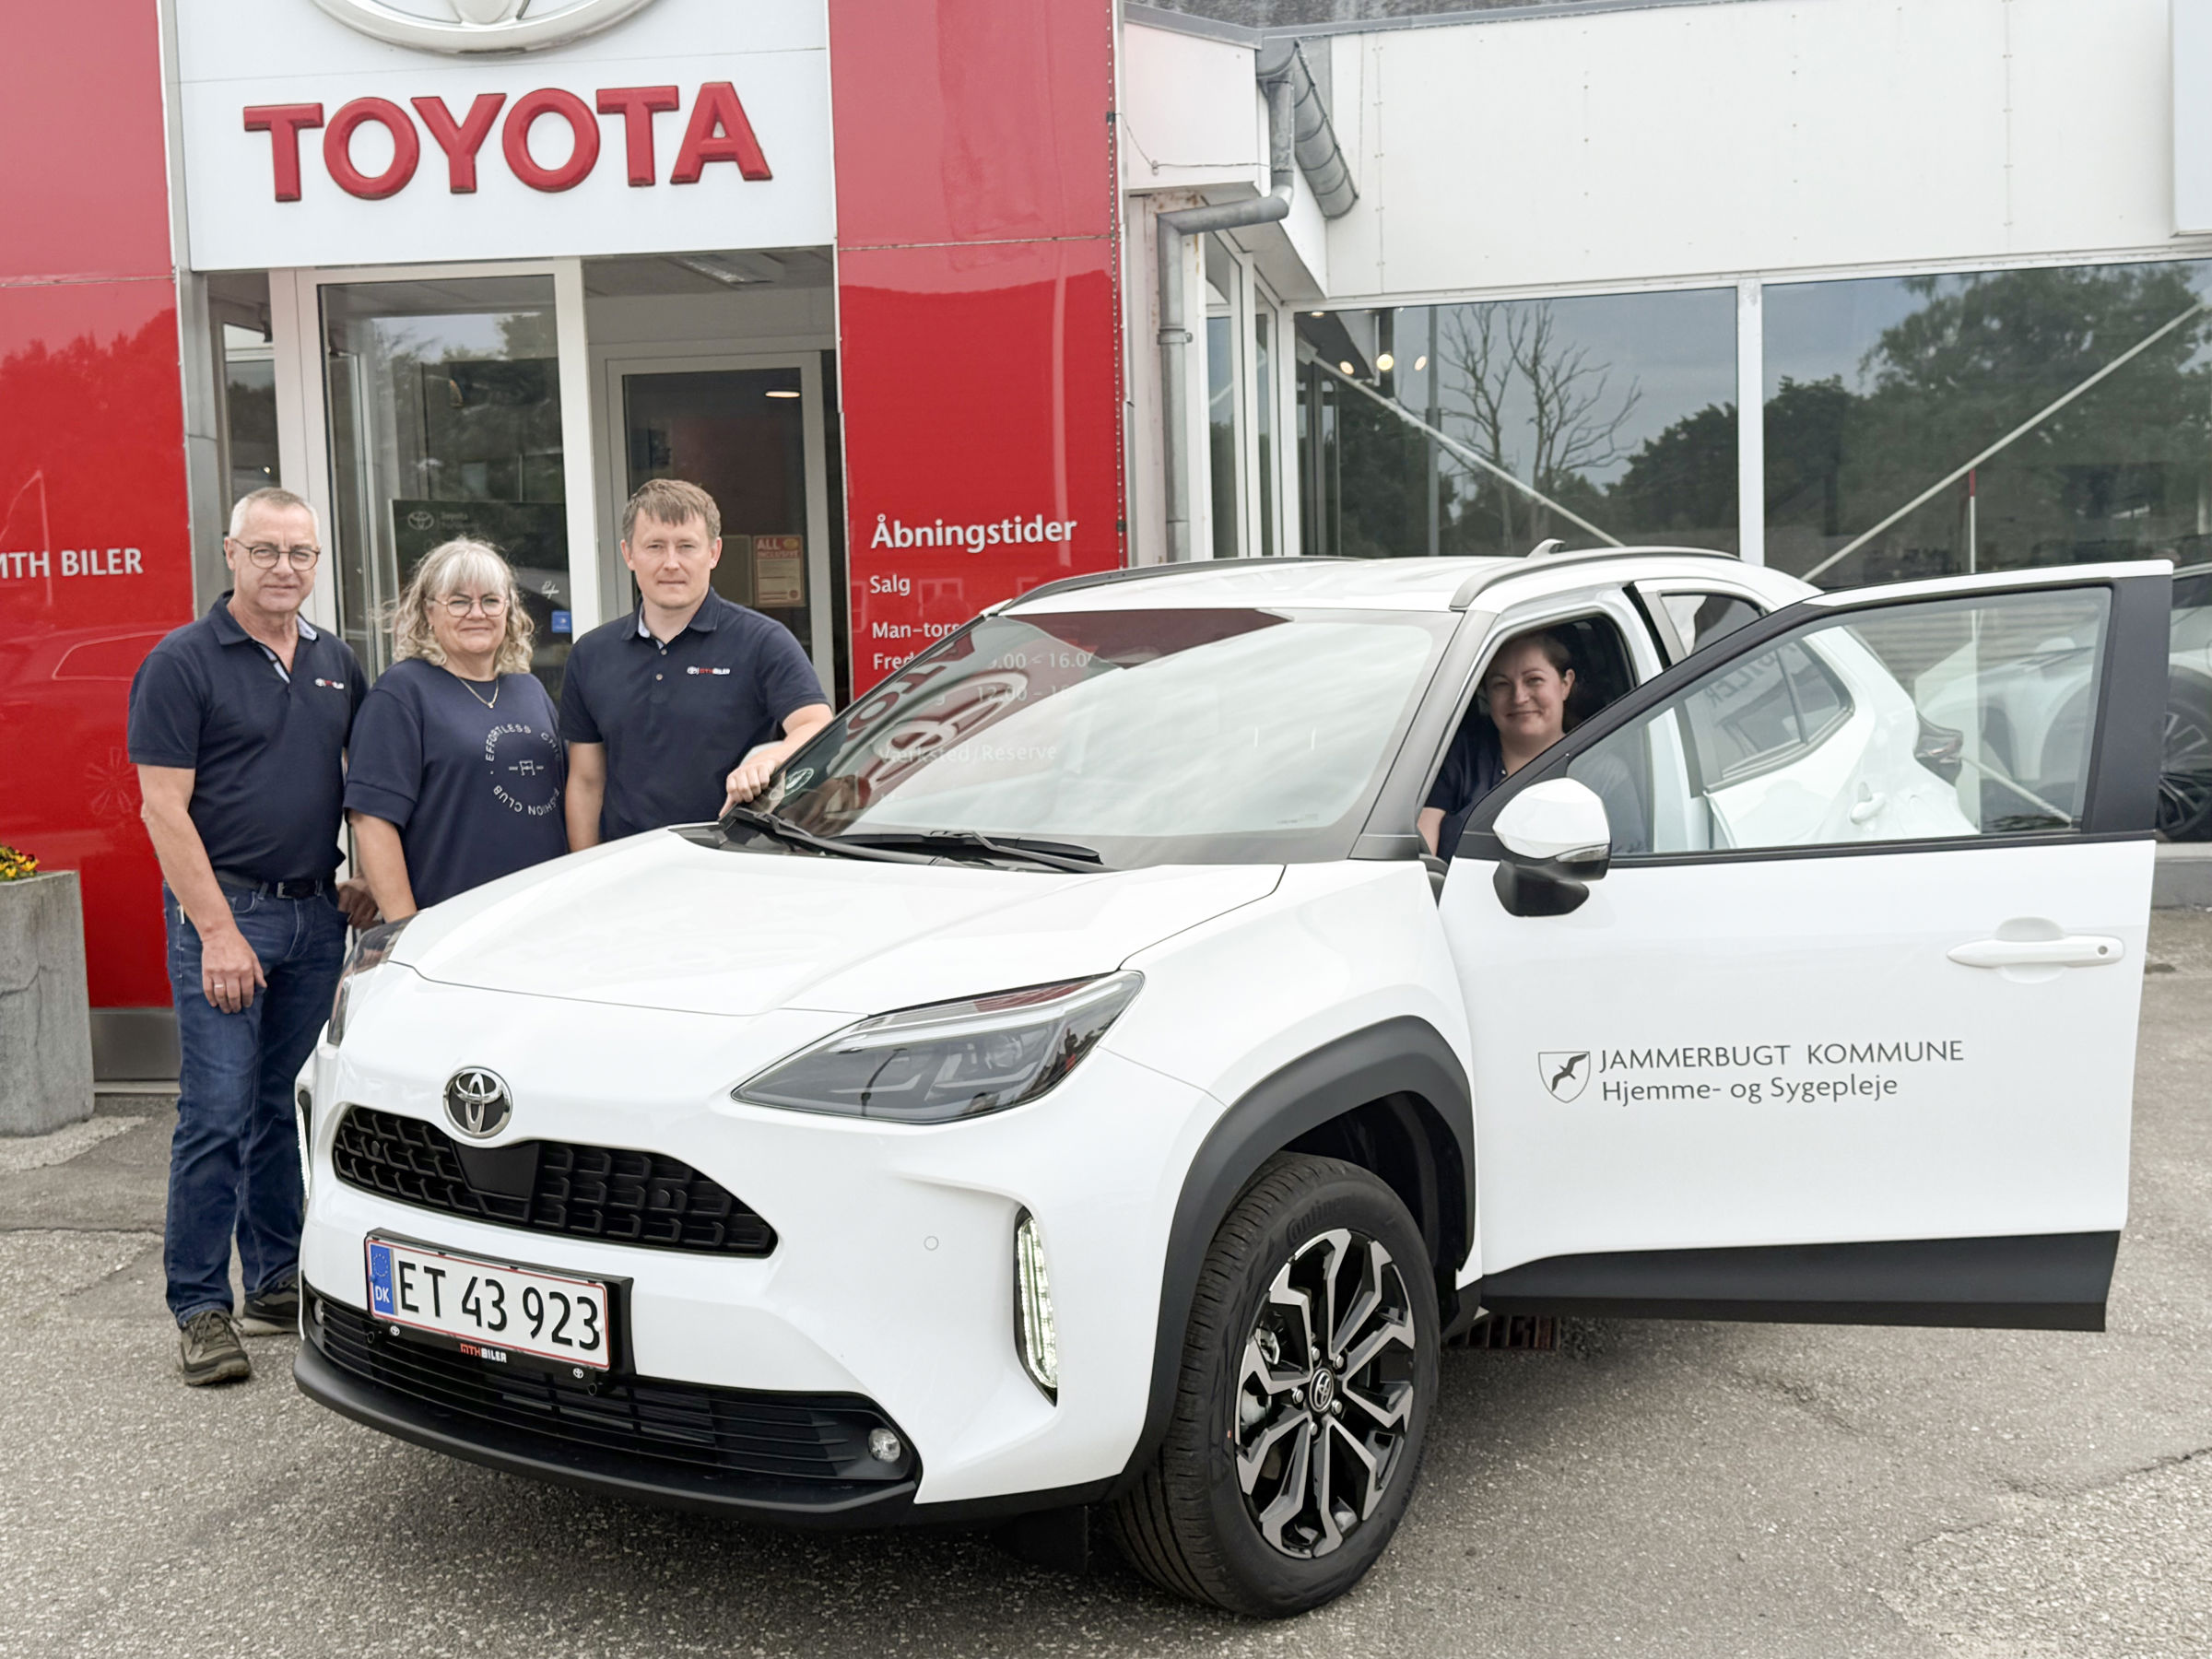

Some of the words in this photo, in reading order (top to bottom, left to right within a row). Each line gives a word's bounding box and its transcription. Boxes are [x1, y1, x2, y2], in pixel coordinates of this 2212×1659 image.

[243, 81, 772, 202] TOYOTA
[758, 537, 782, 550] ALL
[870, 513, 1077, 554] Åbningstider
[61, 547, 144, 577] BILER
[870, 574, 912, 596] Salg
[485, 724, 532, 762] EFFORTLESS
[493, 784, 523, 812] CLUB
[1598, 1044, 1792, 1074] JAMMERBUGT
[1806, 1040, 1965, 1065] KOMMUNE
[1603, 1078, 1722, 1107] Hjemme-
[1730, 1081, 1762, 1104] og
[1771, 1074, 1899, 1104] Sygepleje
[374, 1286, 392, 1304] DK
[398, 1260, 447, 1319] ET
[461, 1276, 509, 1332] 43
[522, 1286, 601, 1351] 923
